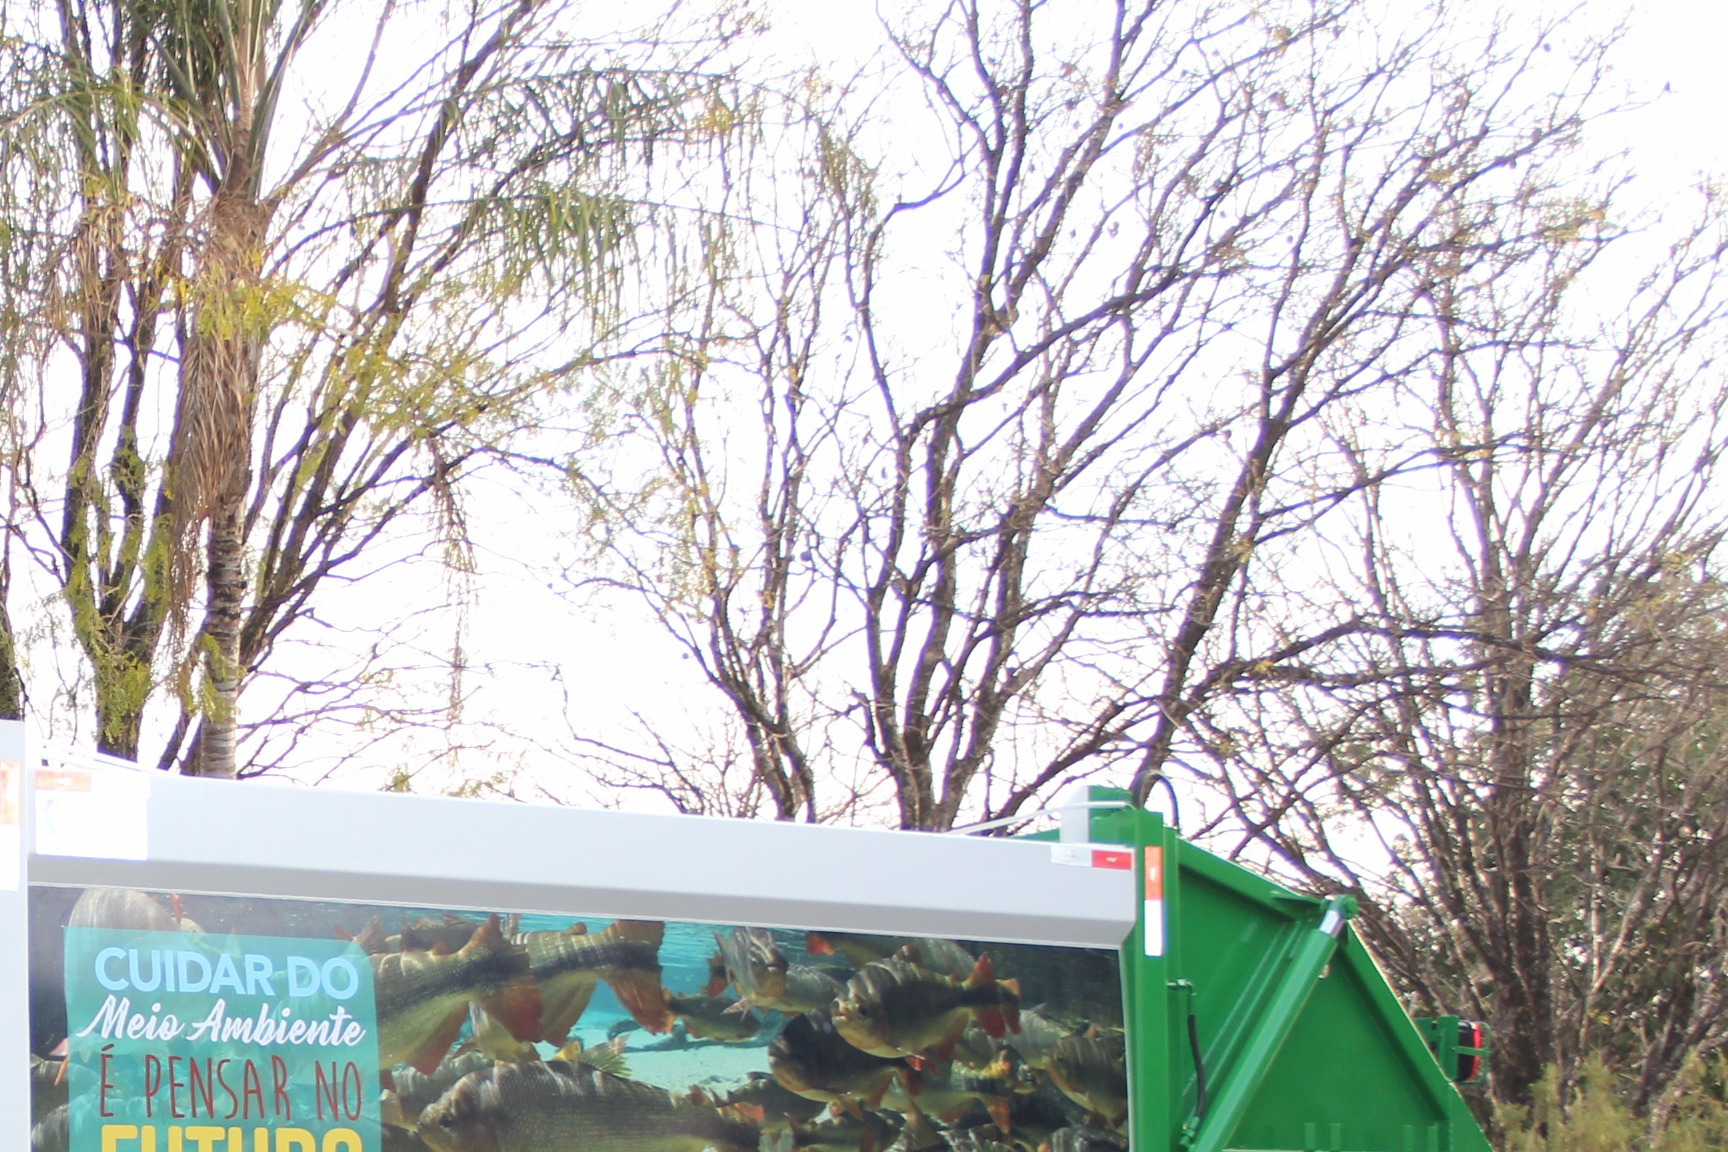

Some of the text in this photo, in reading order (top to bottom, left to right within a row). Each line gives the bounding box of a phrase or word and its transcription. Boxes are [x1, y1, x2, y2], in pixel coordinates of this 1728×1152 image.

[94, 946, 359, 1000] CUIDAR DO
[76, 993, 367, 1047] Meio Ambiente
[99, 1043, 363, 1121] É PENSAR NO
